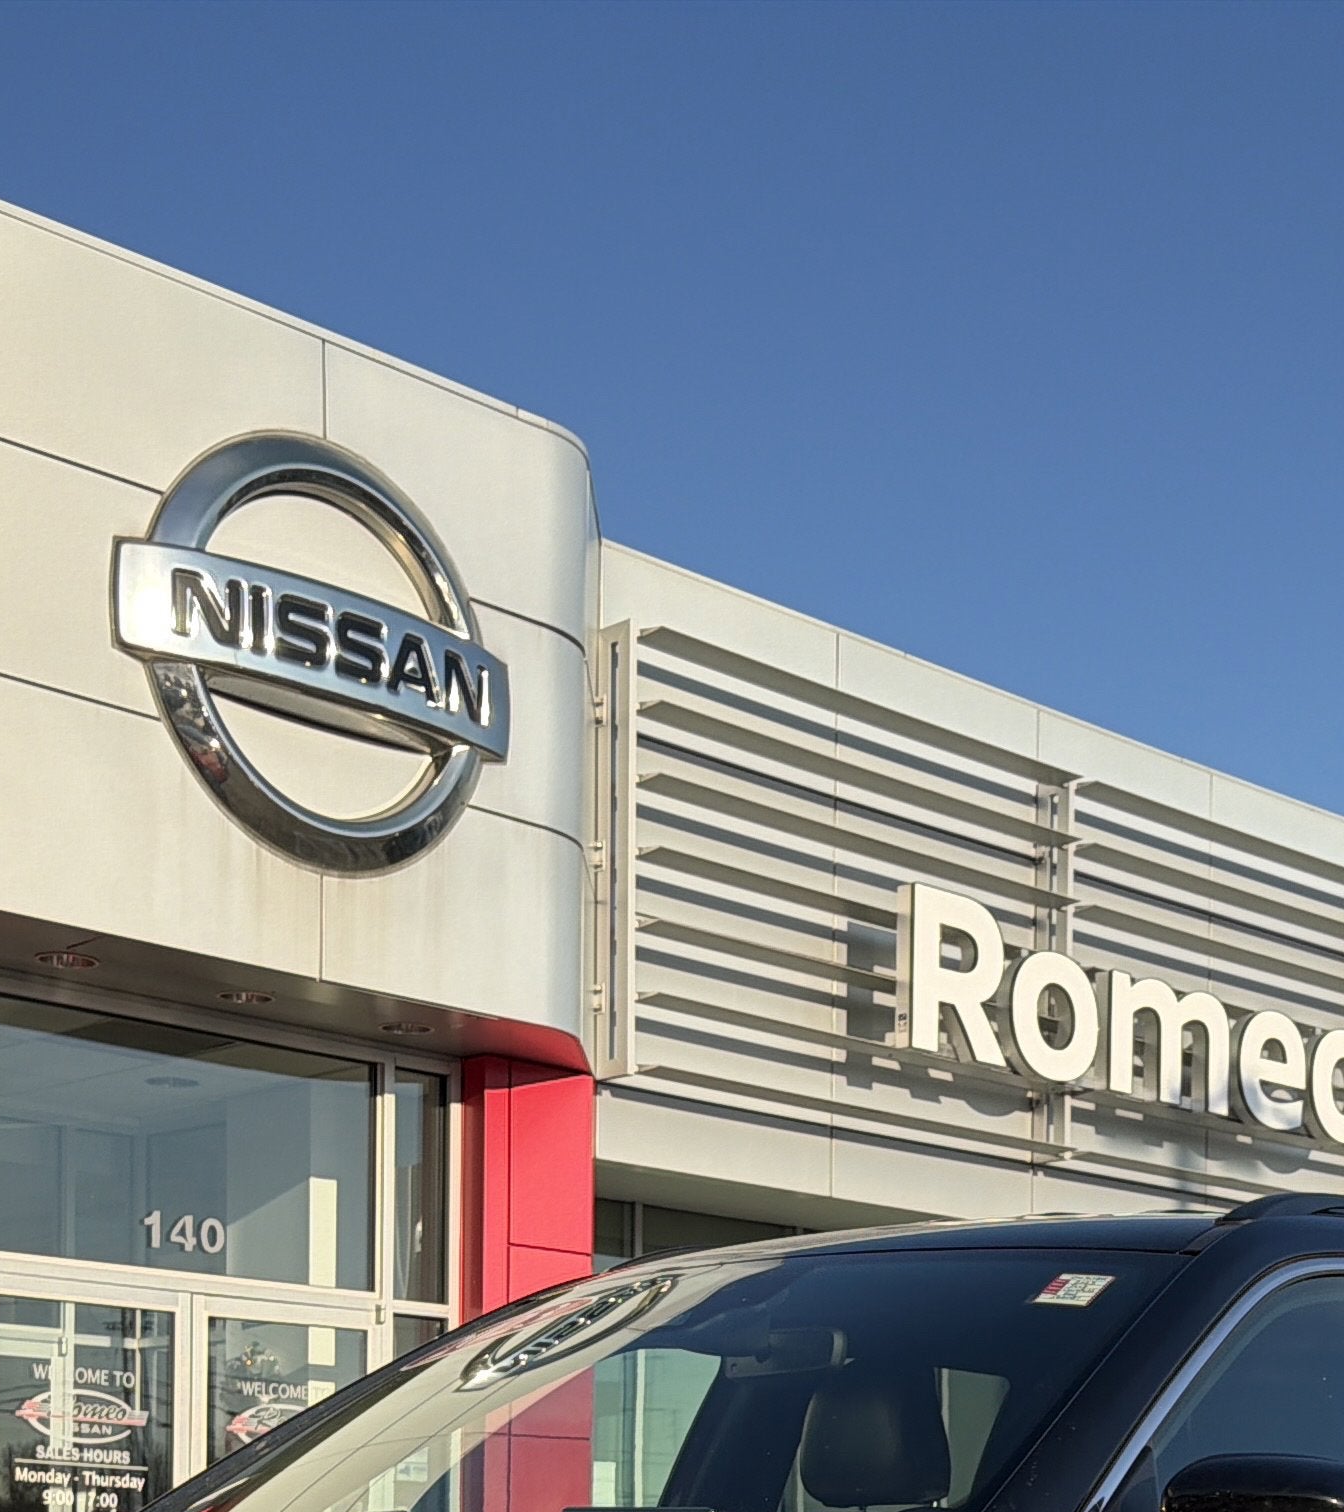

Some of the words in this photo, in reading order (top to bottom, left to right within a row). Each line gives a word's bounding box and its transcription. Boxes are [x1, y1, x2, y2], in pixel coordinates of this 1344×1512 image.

[170, 566, 490, 729] NISSAN
[143, 1210, 225, 1254] 140
[113, 1370, 135, 1388] TO
[241, 1381, 308, 1400] WELCOME
[35, 1445, 81, 1462] SALES
[83, 1447, 131, 1465] HOURS
[15, 1466, 71, 1486] Monday
[81, 1470, 146, 1492] Thursday
